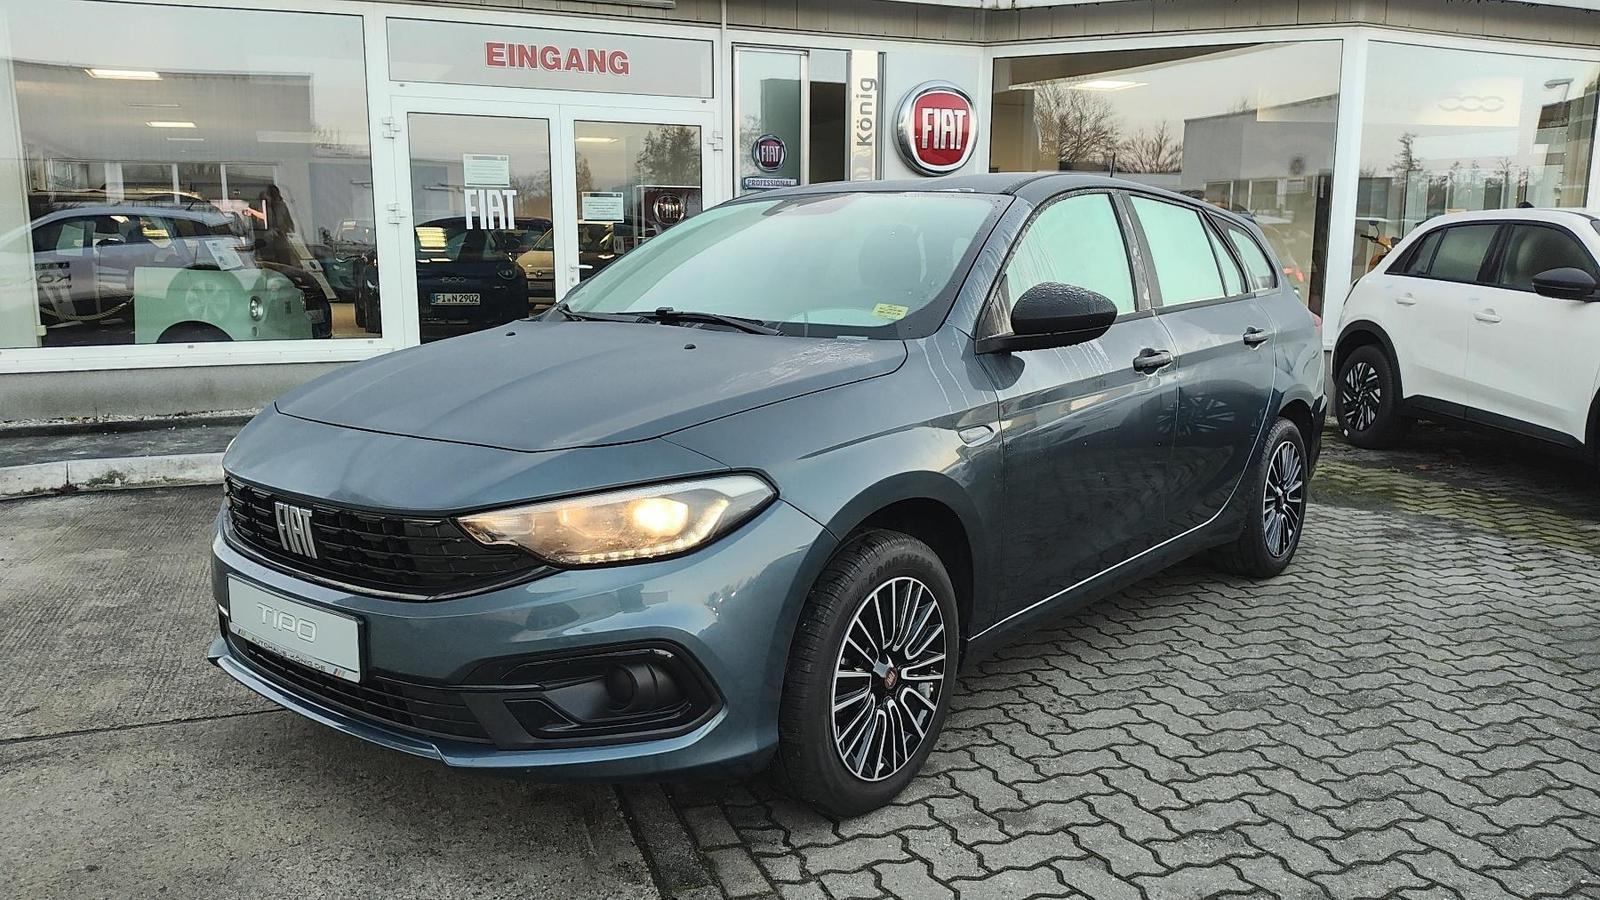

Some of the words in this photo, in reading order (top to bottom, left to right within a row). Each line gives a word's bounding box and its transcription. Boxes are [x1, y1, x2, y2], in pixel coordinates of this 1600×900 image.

[485, 41, 630, 75] EINGANG
[856, 78, 878, 146] König
[921, 107, 967, 150] FIAT
[761, 145, 780, 162] FIAT
[464, 189, 517, 230] FIAT
[274, 501, 318, 559] FIAT
[256, 601, 318, 643] TIPO
